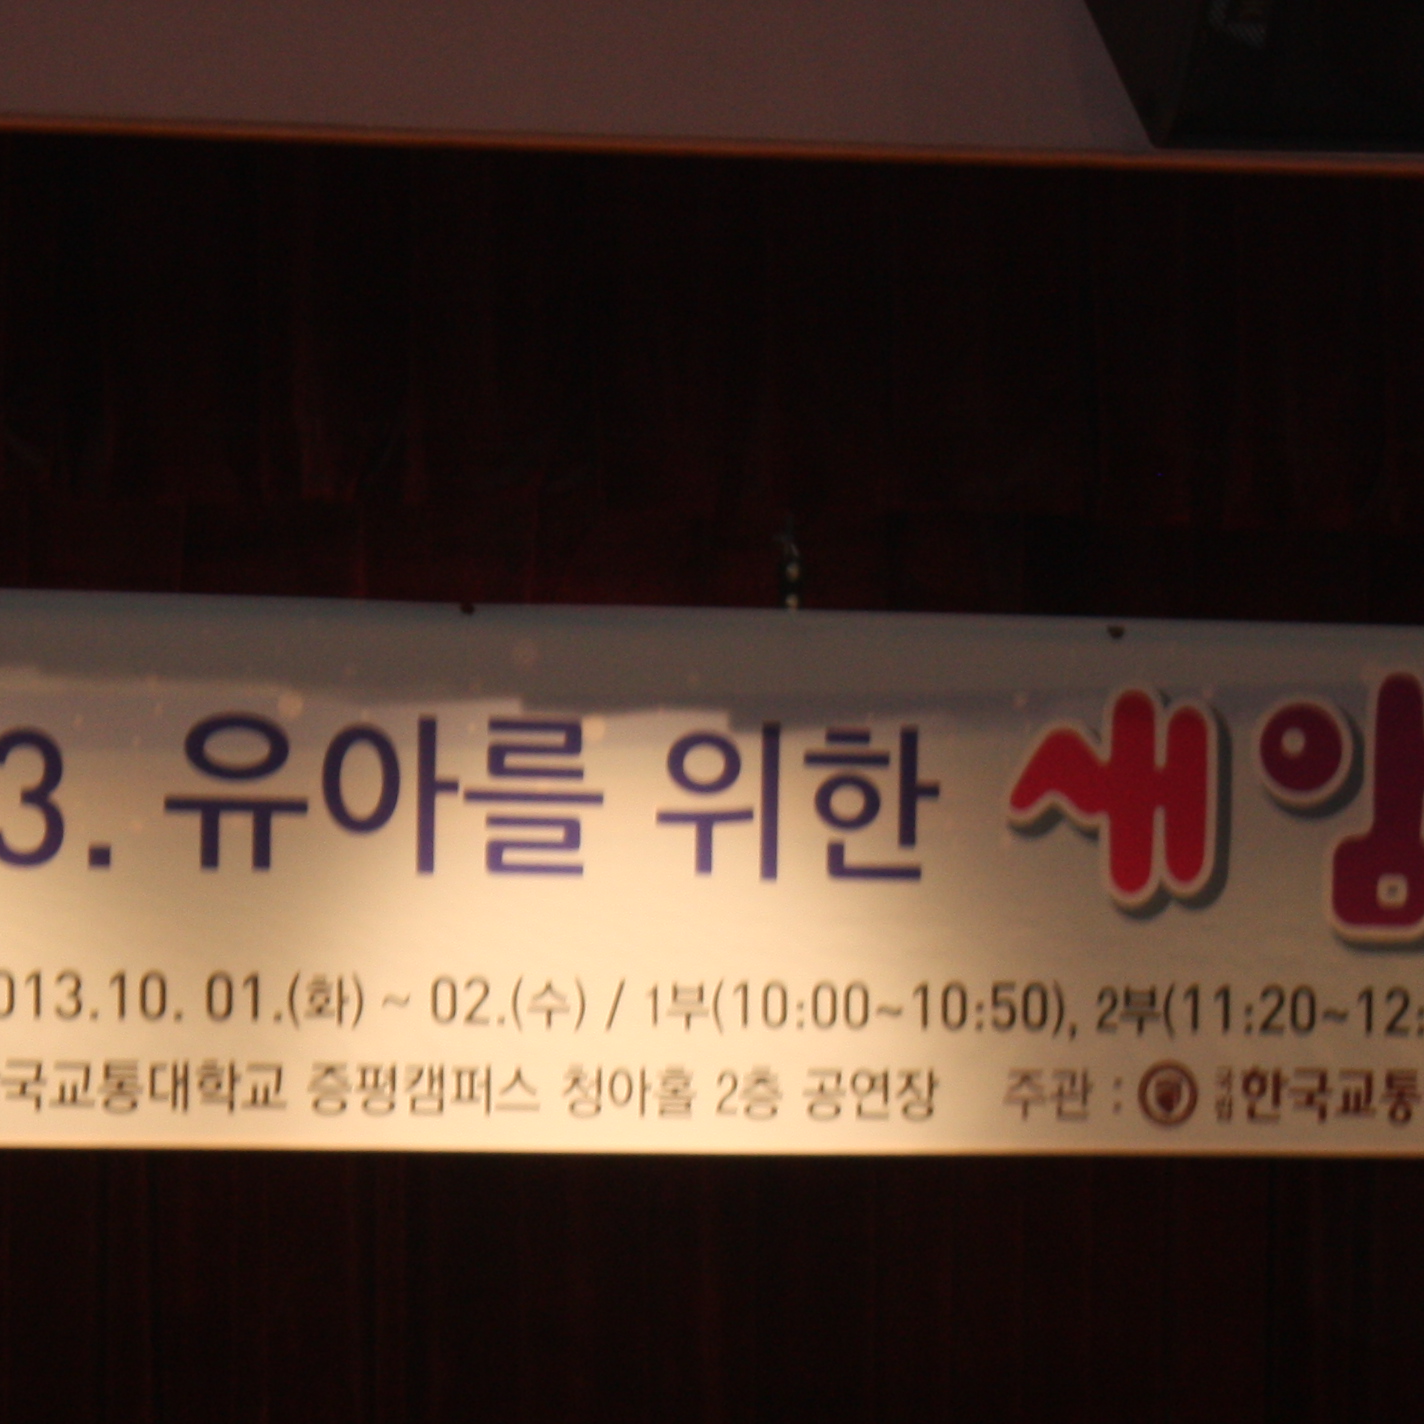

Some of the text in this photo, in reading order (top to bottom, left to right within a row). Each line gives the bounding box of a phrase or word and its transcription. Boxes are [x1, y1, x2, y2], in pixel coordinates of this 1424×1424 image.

[163, 710, 605, 878] 유아를
[655, 718, 941, 883] 위한
[429, 973, 587, 1032] 02.(수)
[305, 1059, 541, 1119] 증평캠퍼스
[561, 1060, 697, 1121] 청아홀
[715, 1062, 784, 1122] 2층
[802, 1065, 941, 1123] 공연장
